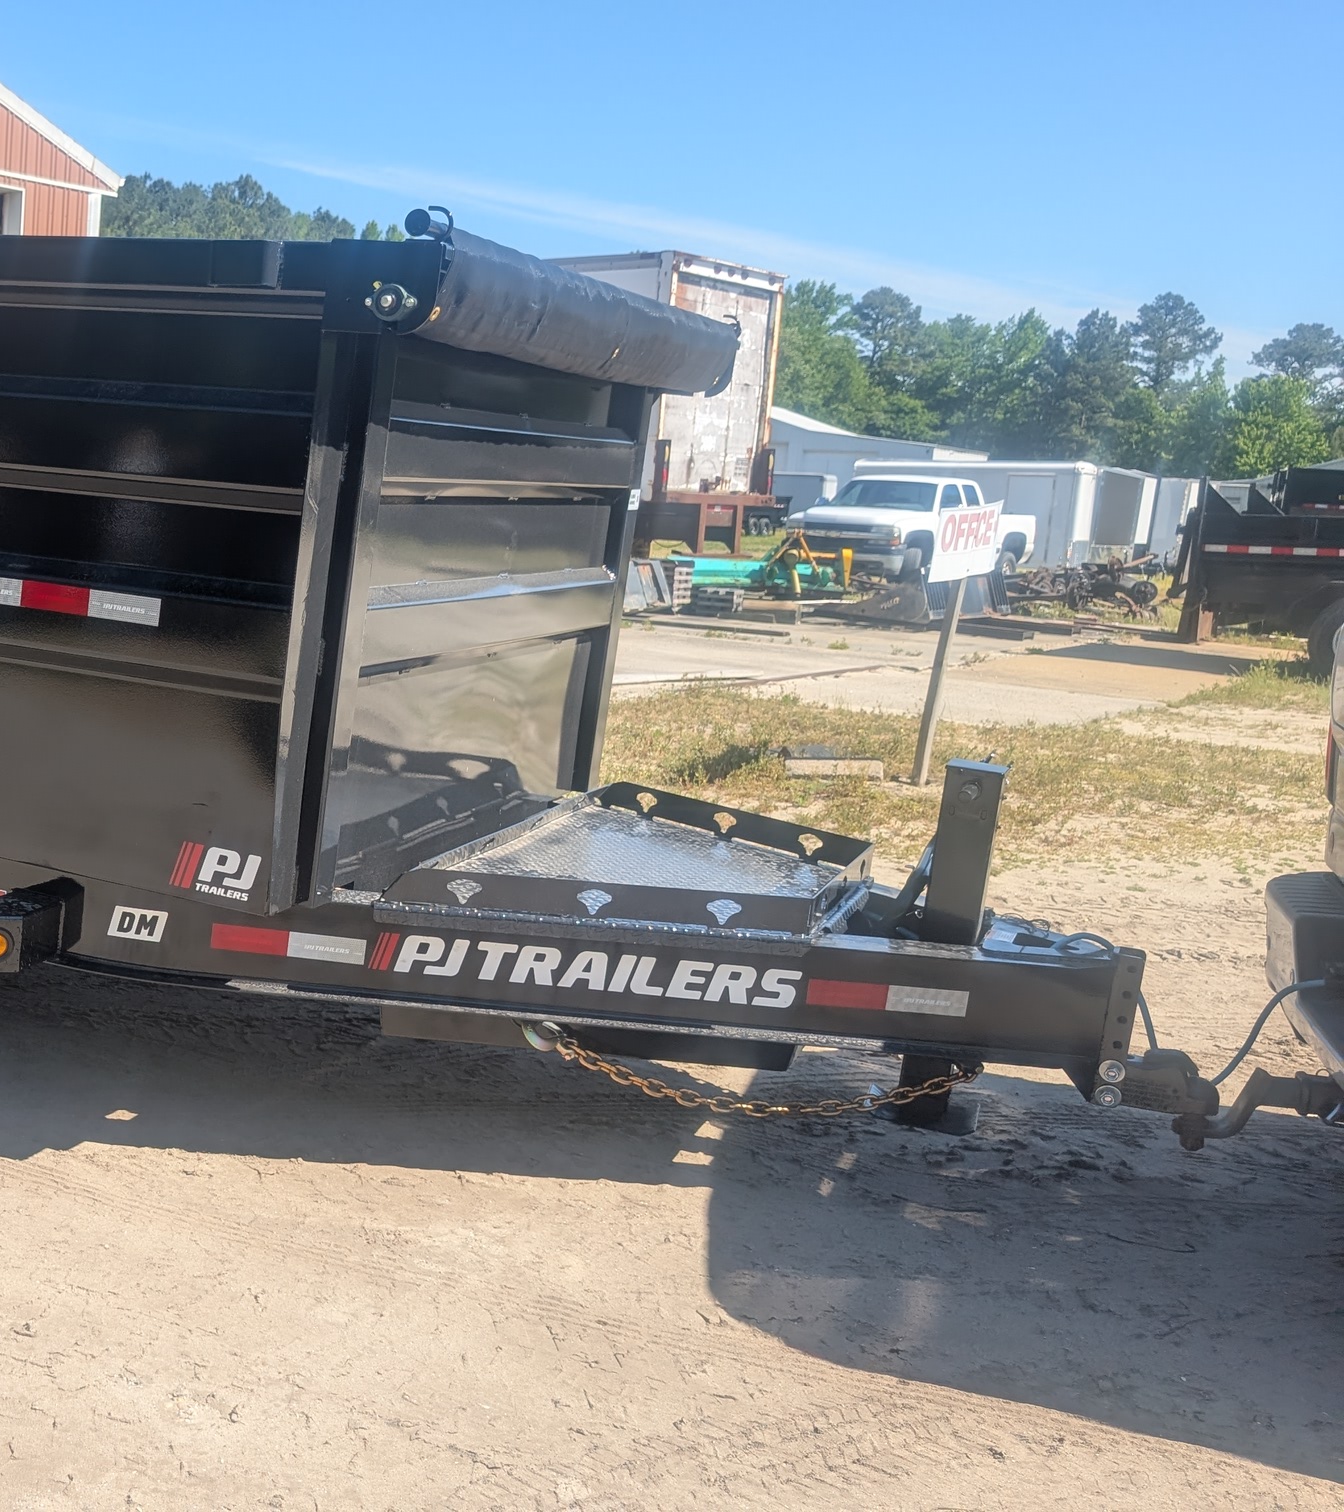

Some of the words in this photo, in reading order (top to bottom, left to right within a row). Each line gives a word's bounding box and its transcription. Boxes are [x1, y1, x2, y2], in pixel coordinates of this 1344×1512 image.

[197, 846, 262, 890] PJ
[195, 882, 249, 901] TRAILERS
[116, 911, 159, 937] DM
